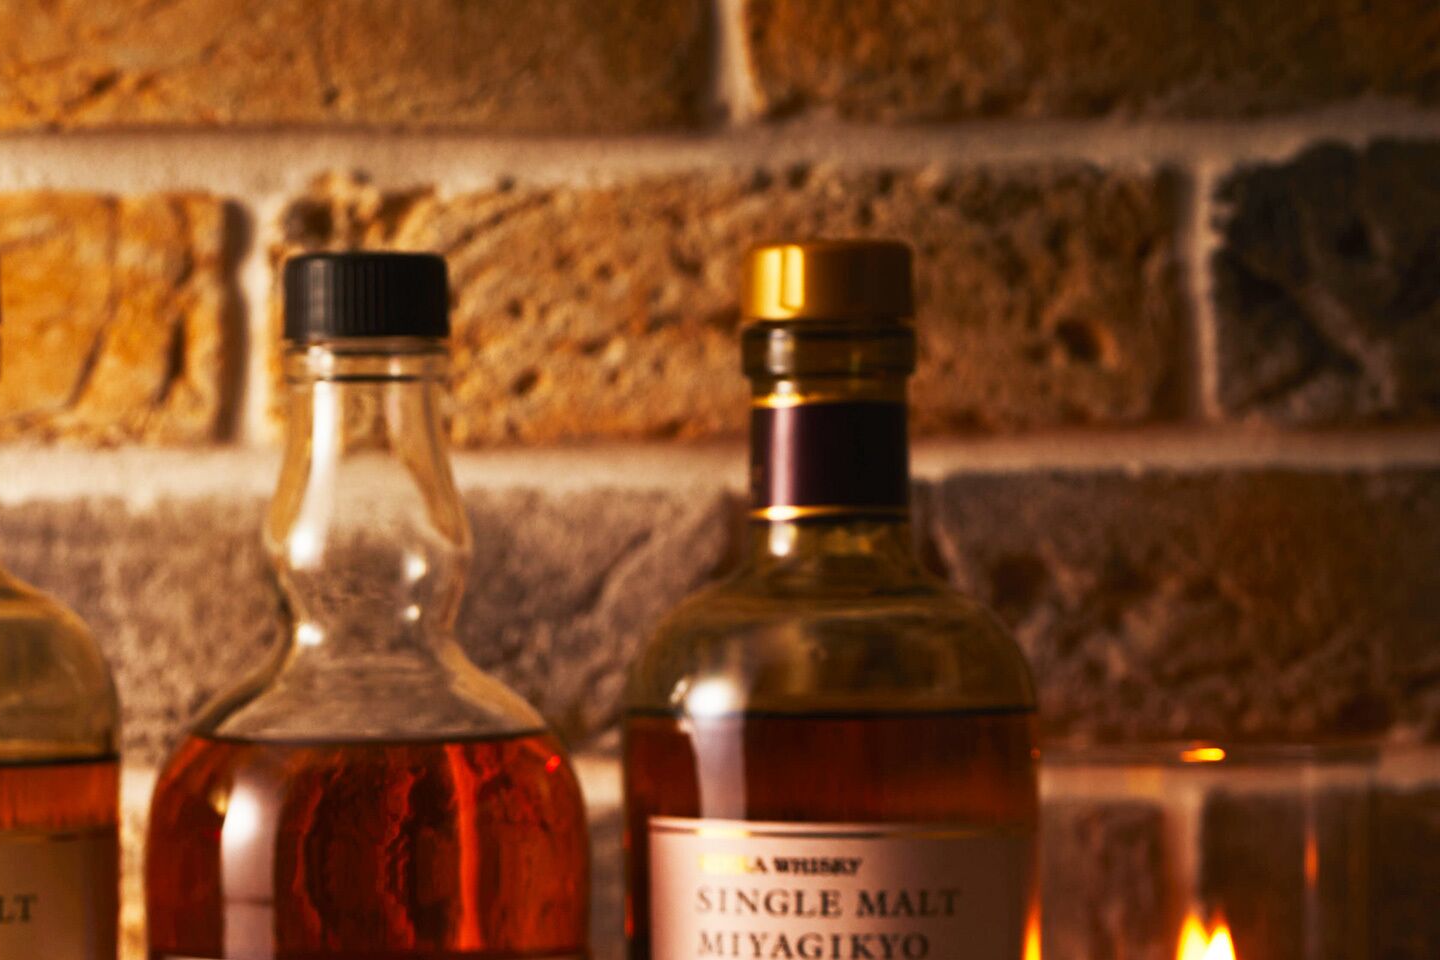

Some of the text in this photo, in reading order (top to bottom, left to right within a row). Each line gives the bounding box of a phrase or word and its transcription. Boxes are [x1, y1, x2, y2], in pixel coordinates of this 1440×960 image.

[772, 857, 863, 875] WHISKY
[696, 886, 958, 917] SINGLE MALT
